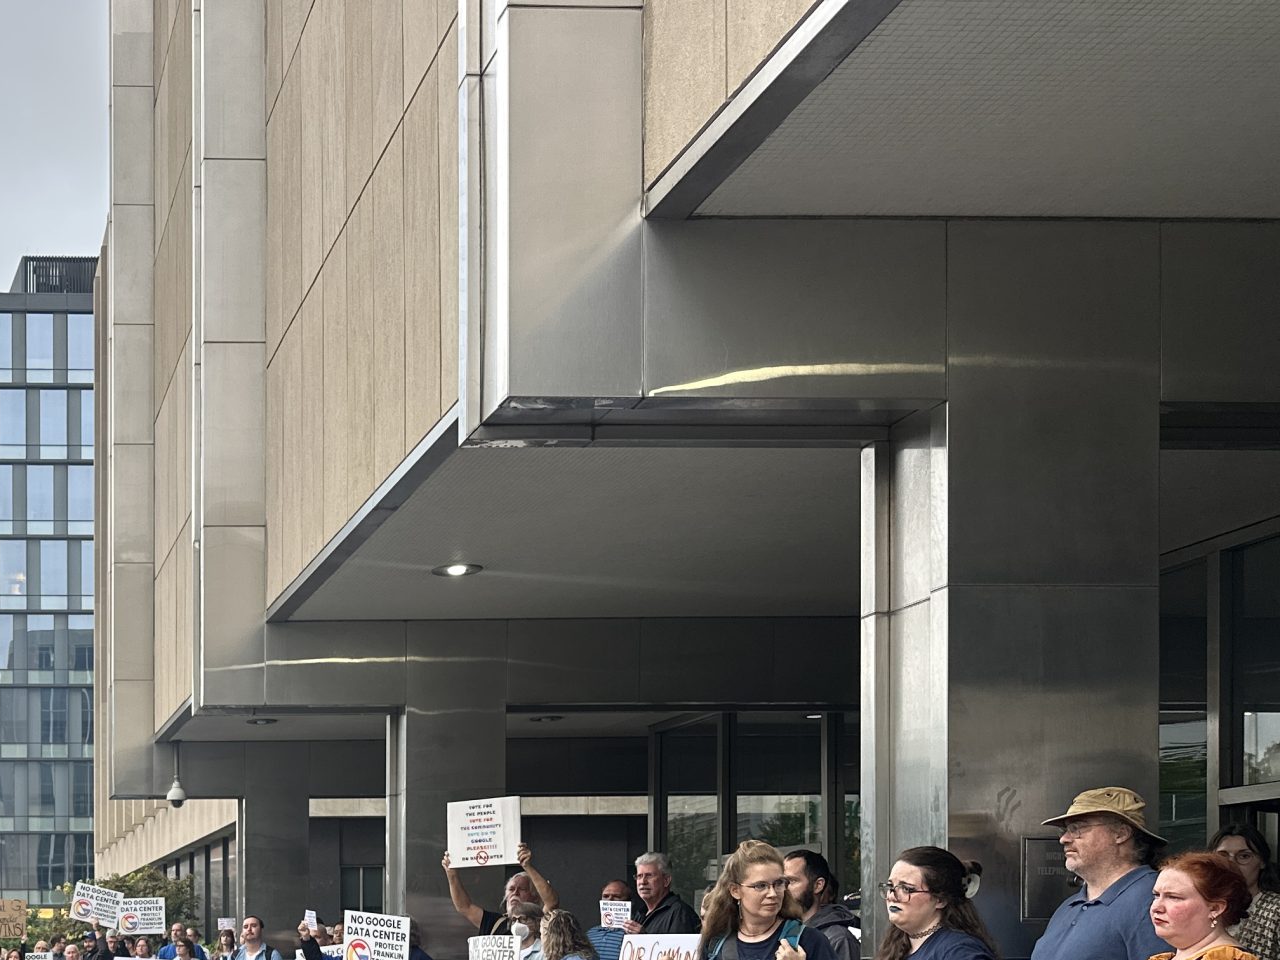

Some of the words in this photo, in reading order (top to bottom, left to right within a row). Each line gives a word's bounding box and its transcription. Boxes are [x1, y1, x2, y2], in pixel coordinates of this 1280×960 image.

[76, 890, 95, 900] DATA
[95, 895, 120, 906] CENTER
[91, 888, 118, 899] GOOGLE
[350, 914, 364, 925] NO
[365, 916, 402, 930] GOOGLE
[347, 926, 371, 938] DATA
[372, 929, 407, 942] CENTER
[374, 941, 404, 951] PROTECT
[481, 936, 514, 949] GOOGLE
[373, 949, 404, 960] FRANKLIN
